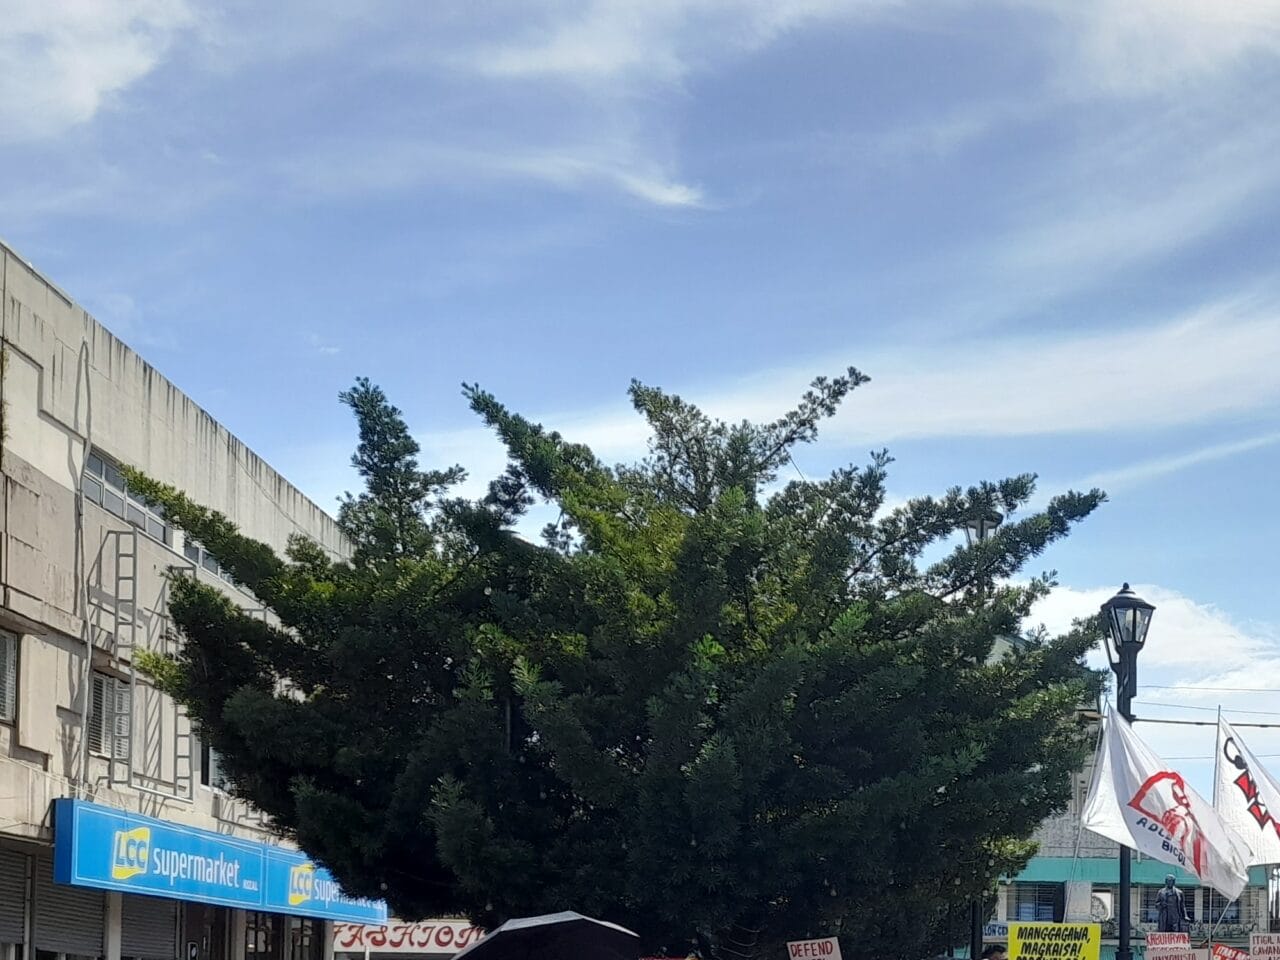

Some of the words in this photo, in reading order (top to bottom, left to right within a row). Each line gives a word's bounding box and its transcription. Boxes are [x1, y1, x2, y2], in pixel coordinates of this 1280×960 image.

[115, 833, 148, 868] LCC
[152, 847, 241, 889] supermarket
[1017, 926, 1091, 944] MANGGAGAWA,
[790, 940, 833, 958] DEFEND
[1021, 942, 1083, 958] MAGKAISA!
